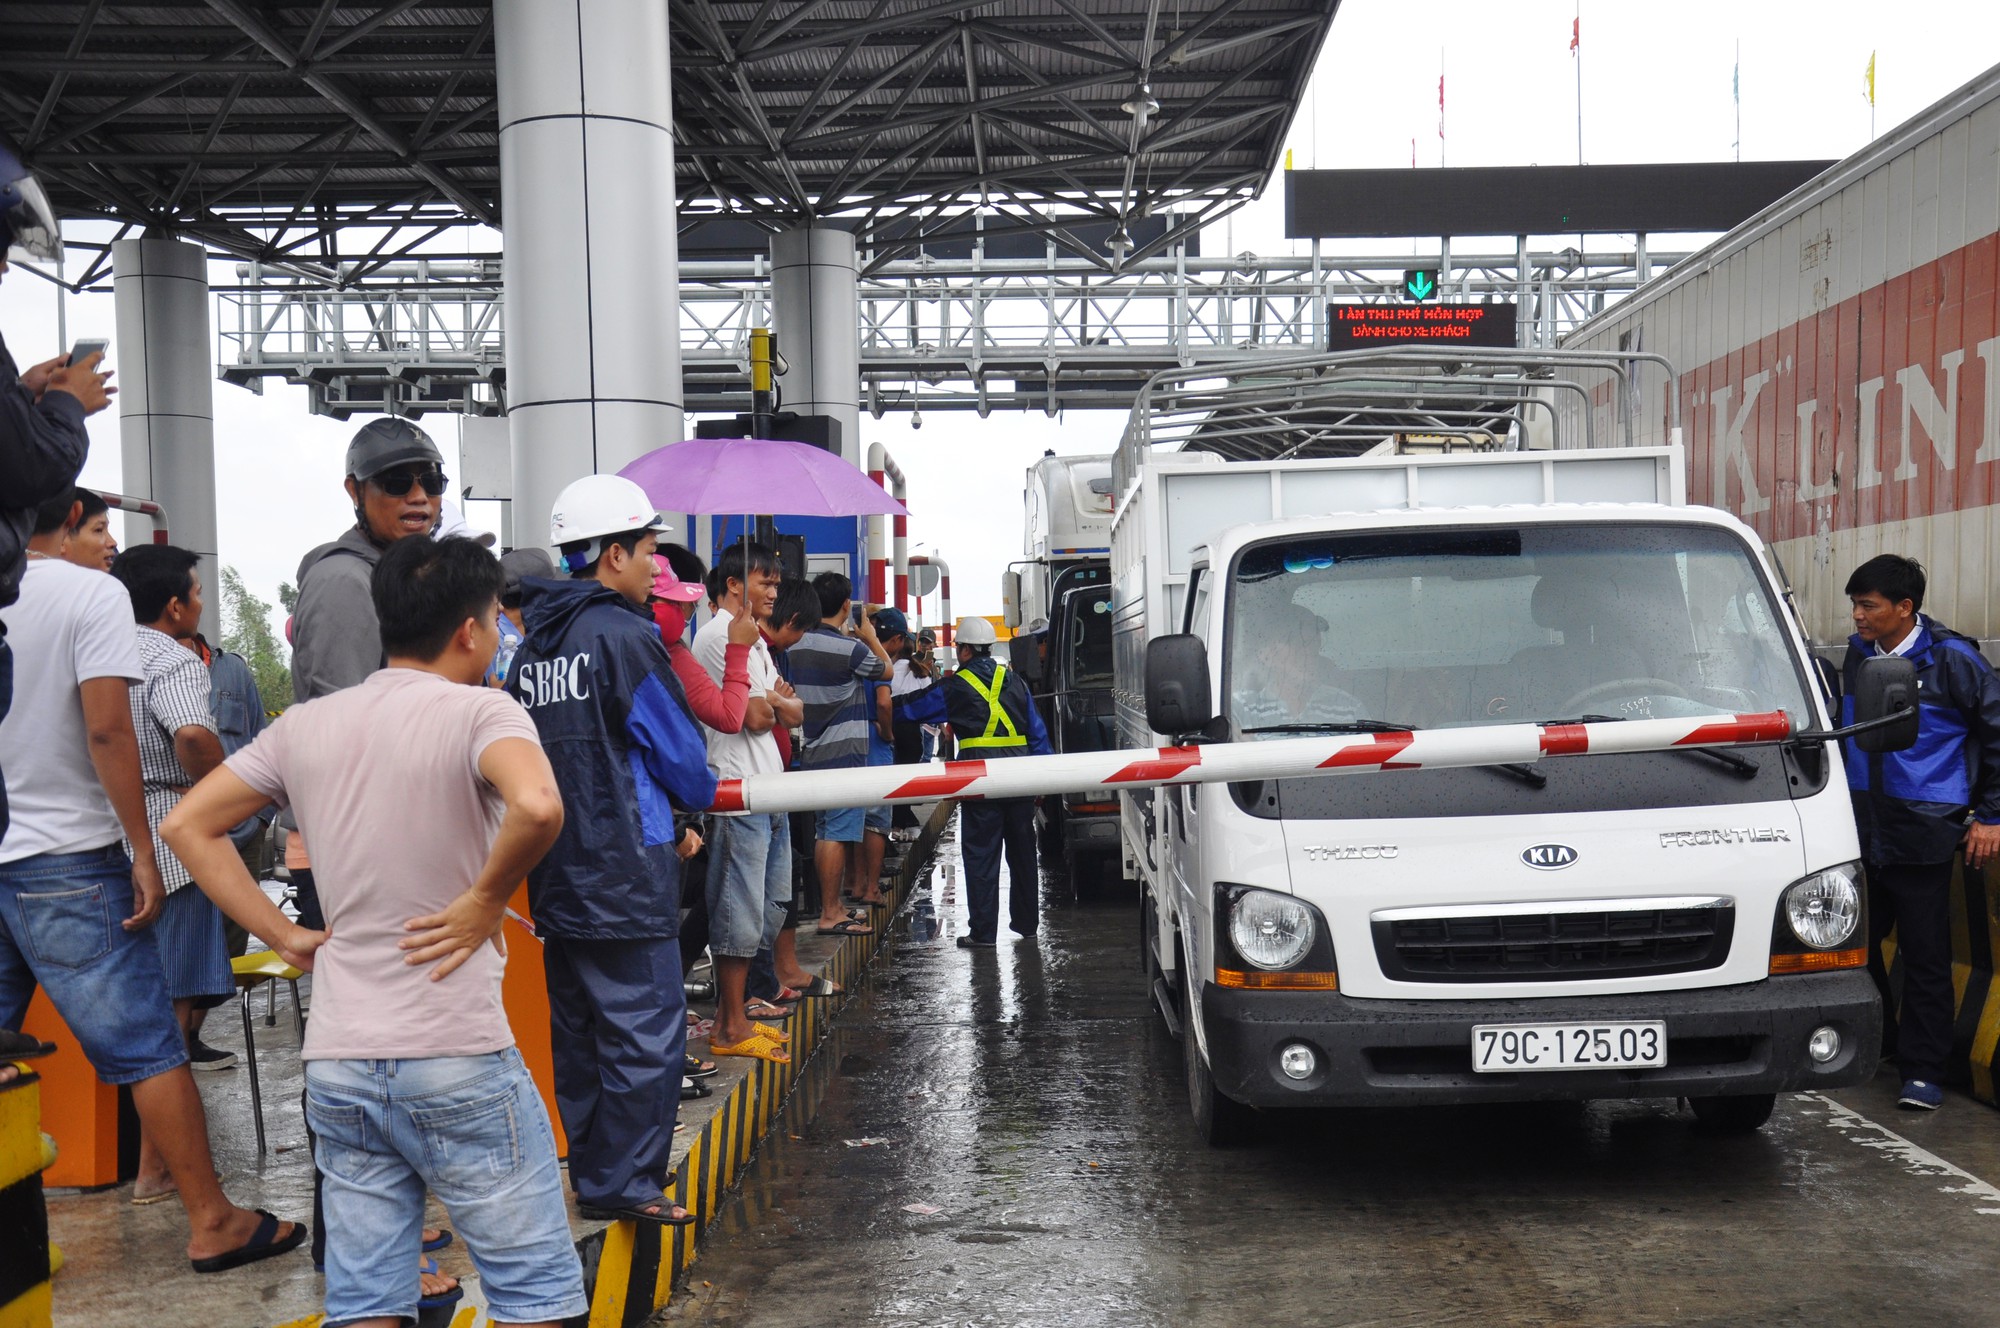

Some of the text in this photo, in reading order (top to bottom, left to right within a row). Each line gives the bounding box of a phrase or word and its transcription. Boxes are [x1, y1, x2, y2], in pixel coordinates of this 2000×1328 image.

[1367, 308, 1395, 320] THU
[1397, 307, 1421, 320] PHÍ
[1352, 323, 1470, 337] DÀNH CHO XE KHÁCH
[519, 652, 590, 710] SBRC
[1659, 827, 1792, 848] FRONTIER
[1303, 844, 1399, 861] THACO
[1529, 847, 1569, 864] KIA
[1479, 1027, 1659, 1066] 79C-125.03
